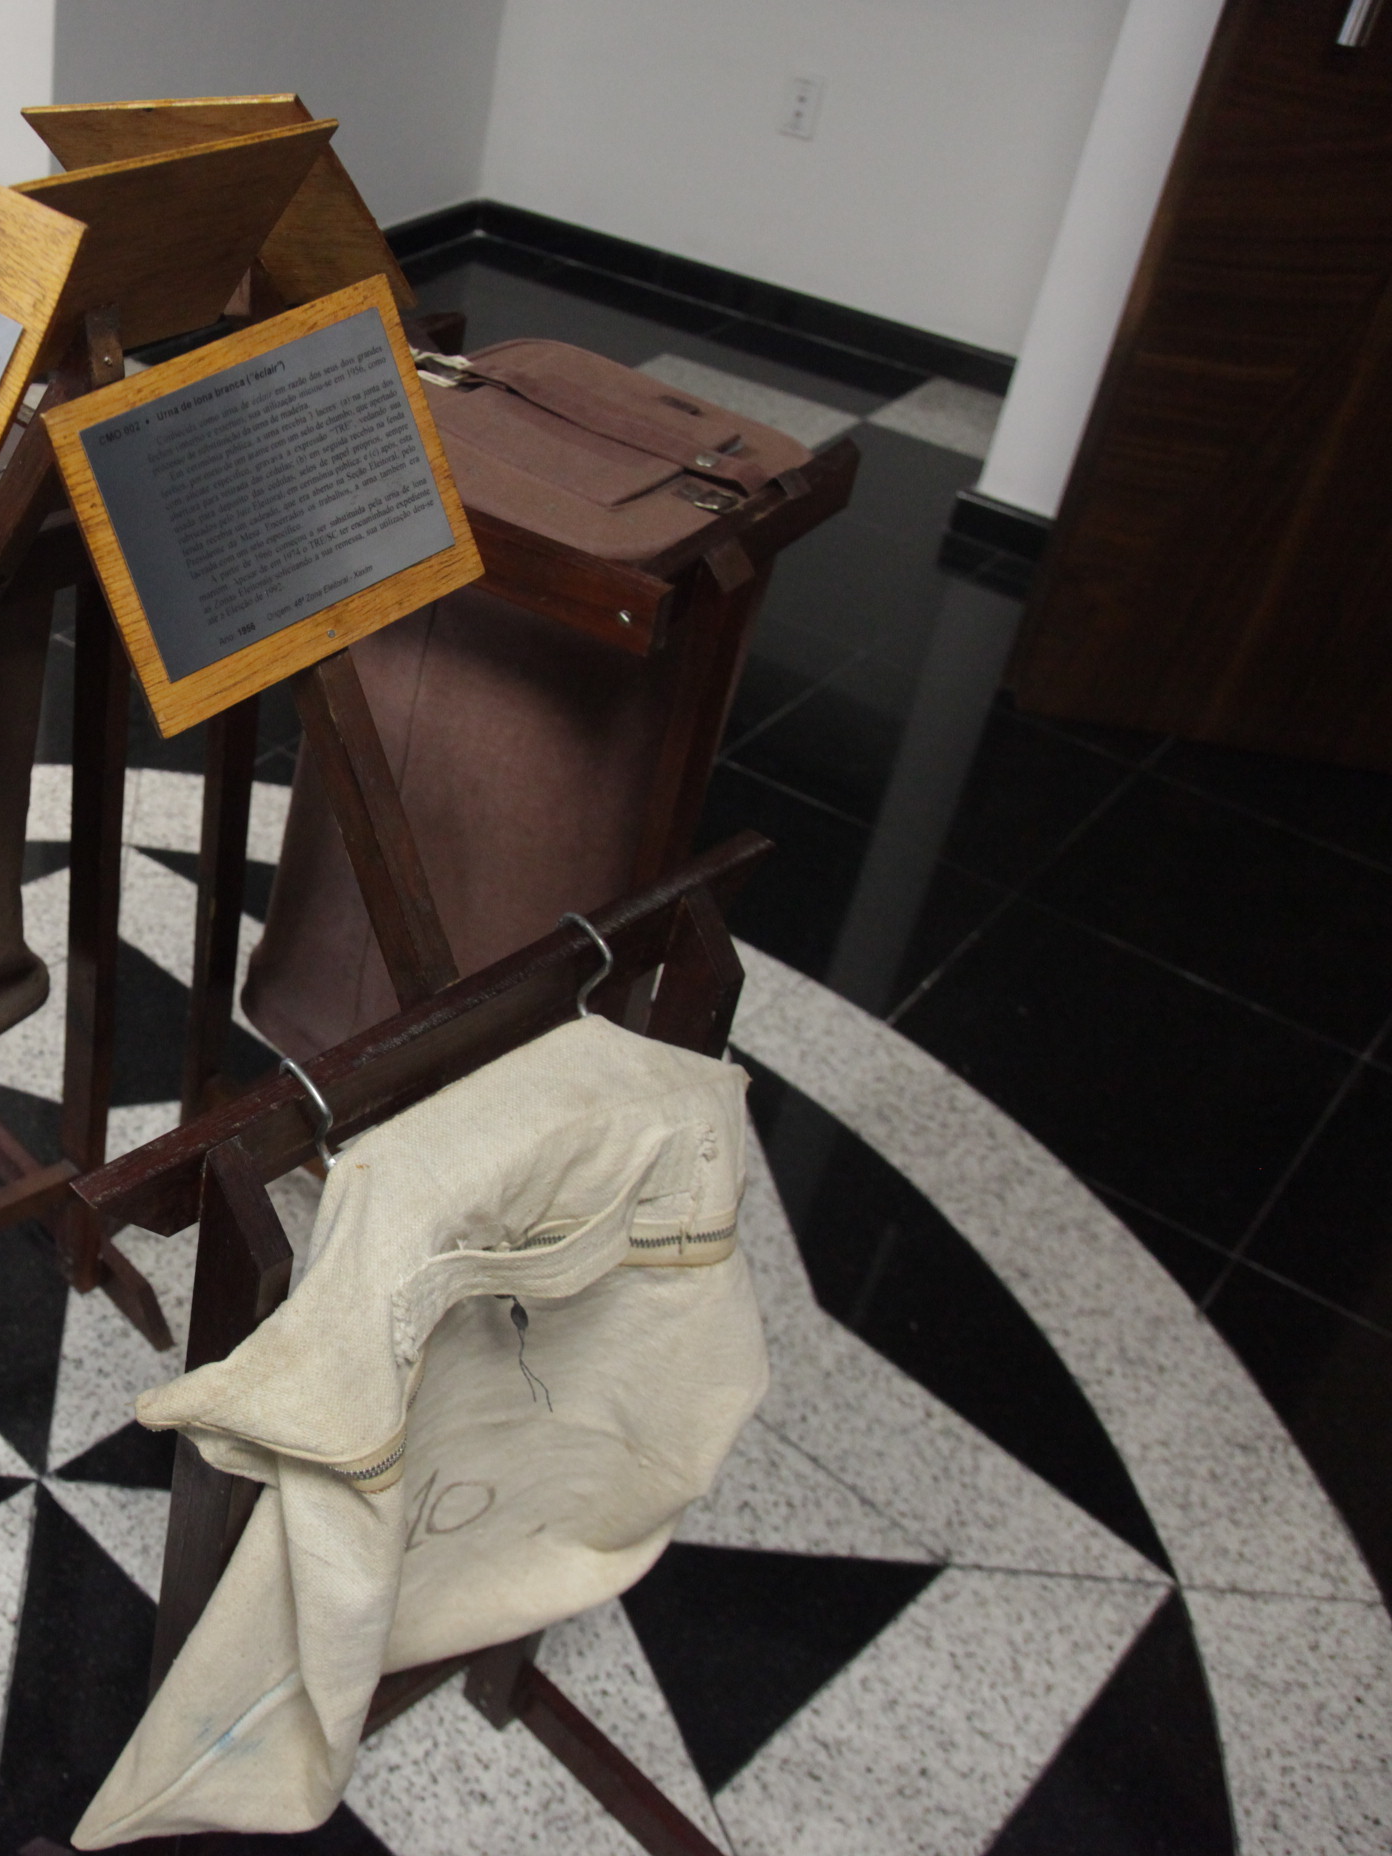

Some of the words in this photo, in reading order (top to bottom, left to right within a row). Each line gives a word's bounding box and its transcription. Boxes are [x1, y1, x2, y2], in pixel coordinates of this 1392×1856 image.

[288, 376, 307, 390] razão
[308, 371, 321, 381] dos
[323, 364, 338, 375] seus
[357, 345, 382, 363] grandes
[368, 356, 386, 369] como
[369, 389, 398, 407] apertado
[98, 429, 122, 446] CMO
[123, 421, 140, 436] 002
[156, 406, 179, 422] Urna
[180, 400, 192, 412] de
[193, 391, 213, 406] lona
[214, 378, 245, 397] branca
[331, 447, 350, 464] papel
